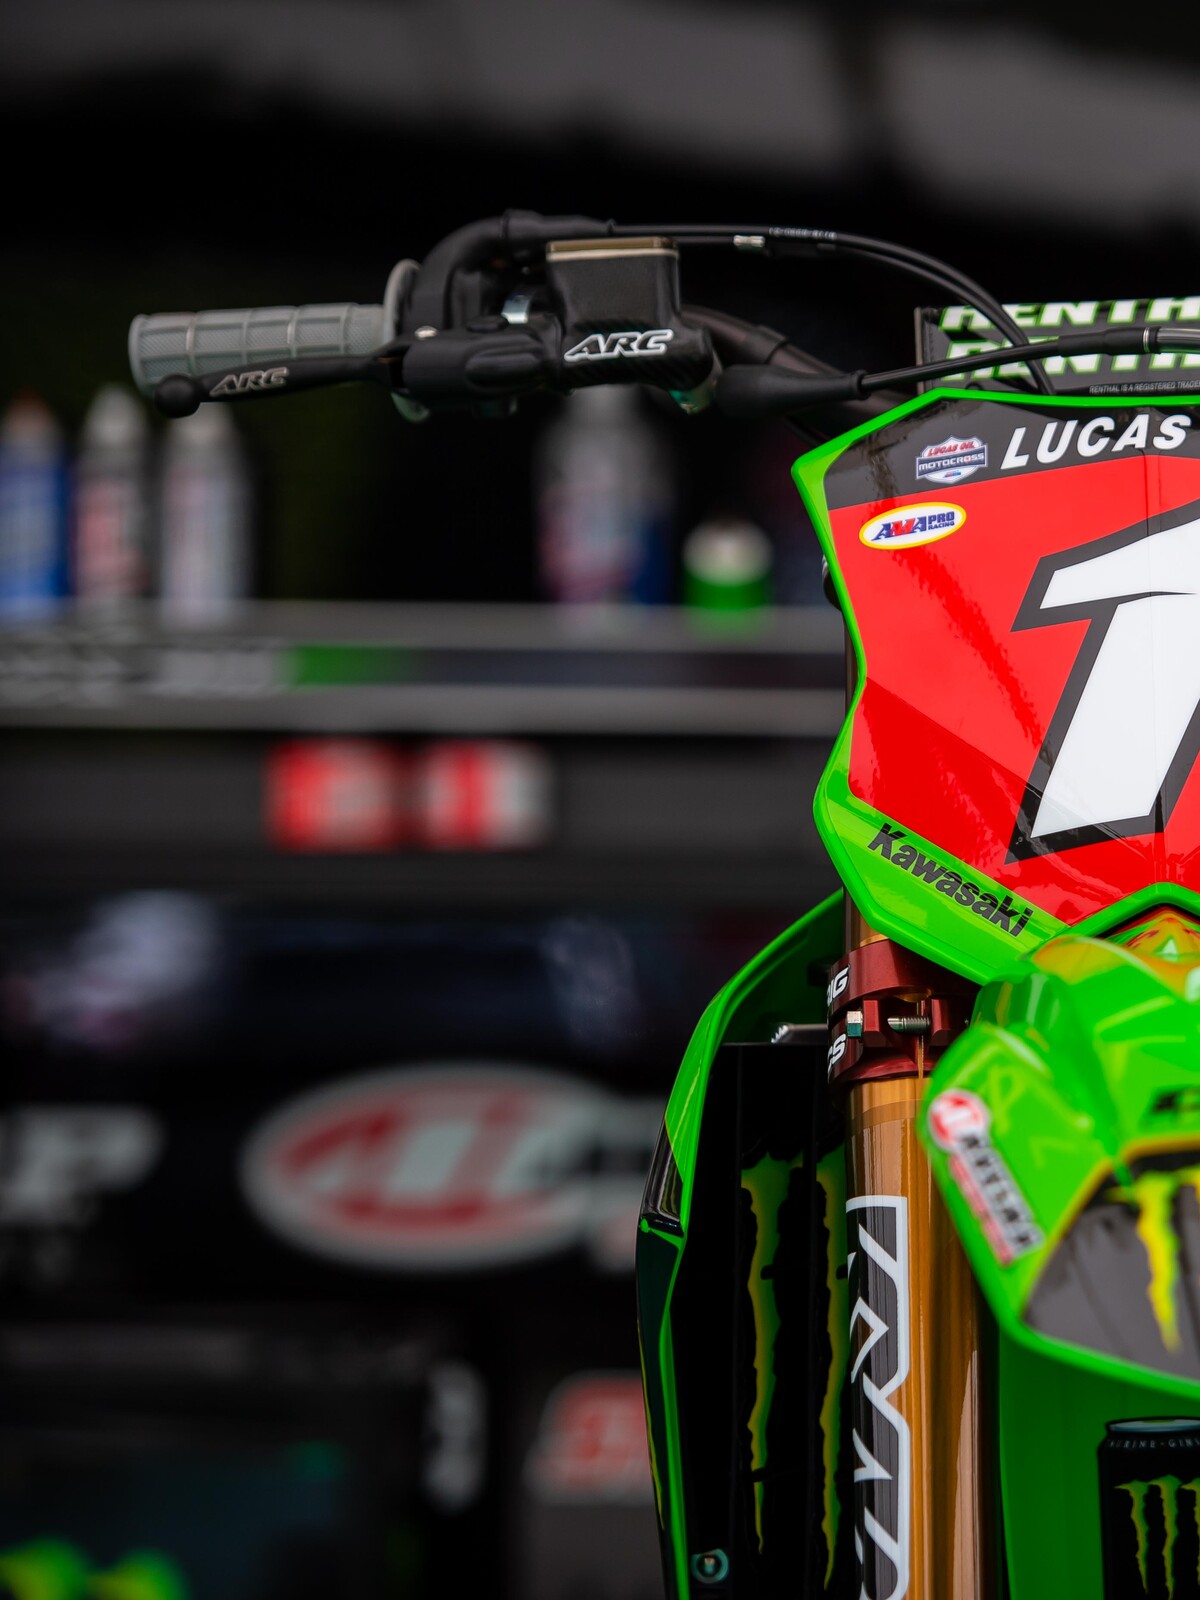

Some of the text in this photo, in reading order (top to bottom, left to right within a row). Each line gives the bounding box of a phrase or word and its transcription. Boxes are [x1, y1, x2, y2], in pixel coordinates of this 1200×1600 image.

[564, 329, 674, 362] ARC
[209, 366, 289, 397] ARC
[1089, 384, 1119, 393] RENTHAL
[1121, 384, 1128, 392] IS
[1134, 381, 1176, 392] REGISTERED
[928, 441, 975, 457] LUCAS OIL
[1000, 414, 1192, 470] LUCAS
[918, 452, 985, 471] MOTOCROSS
[871, 516, 927, 541] AMA
[927, 511, 955, 524] PRO
[927, 521, 955, 530] RACING
[867, 822, 1034, 937] Kawasaki
